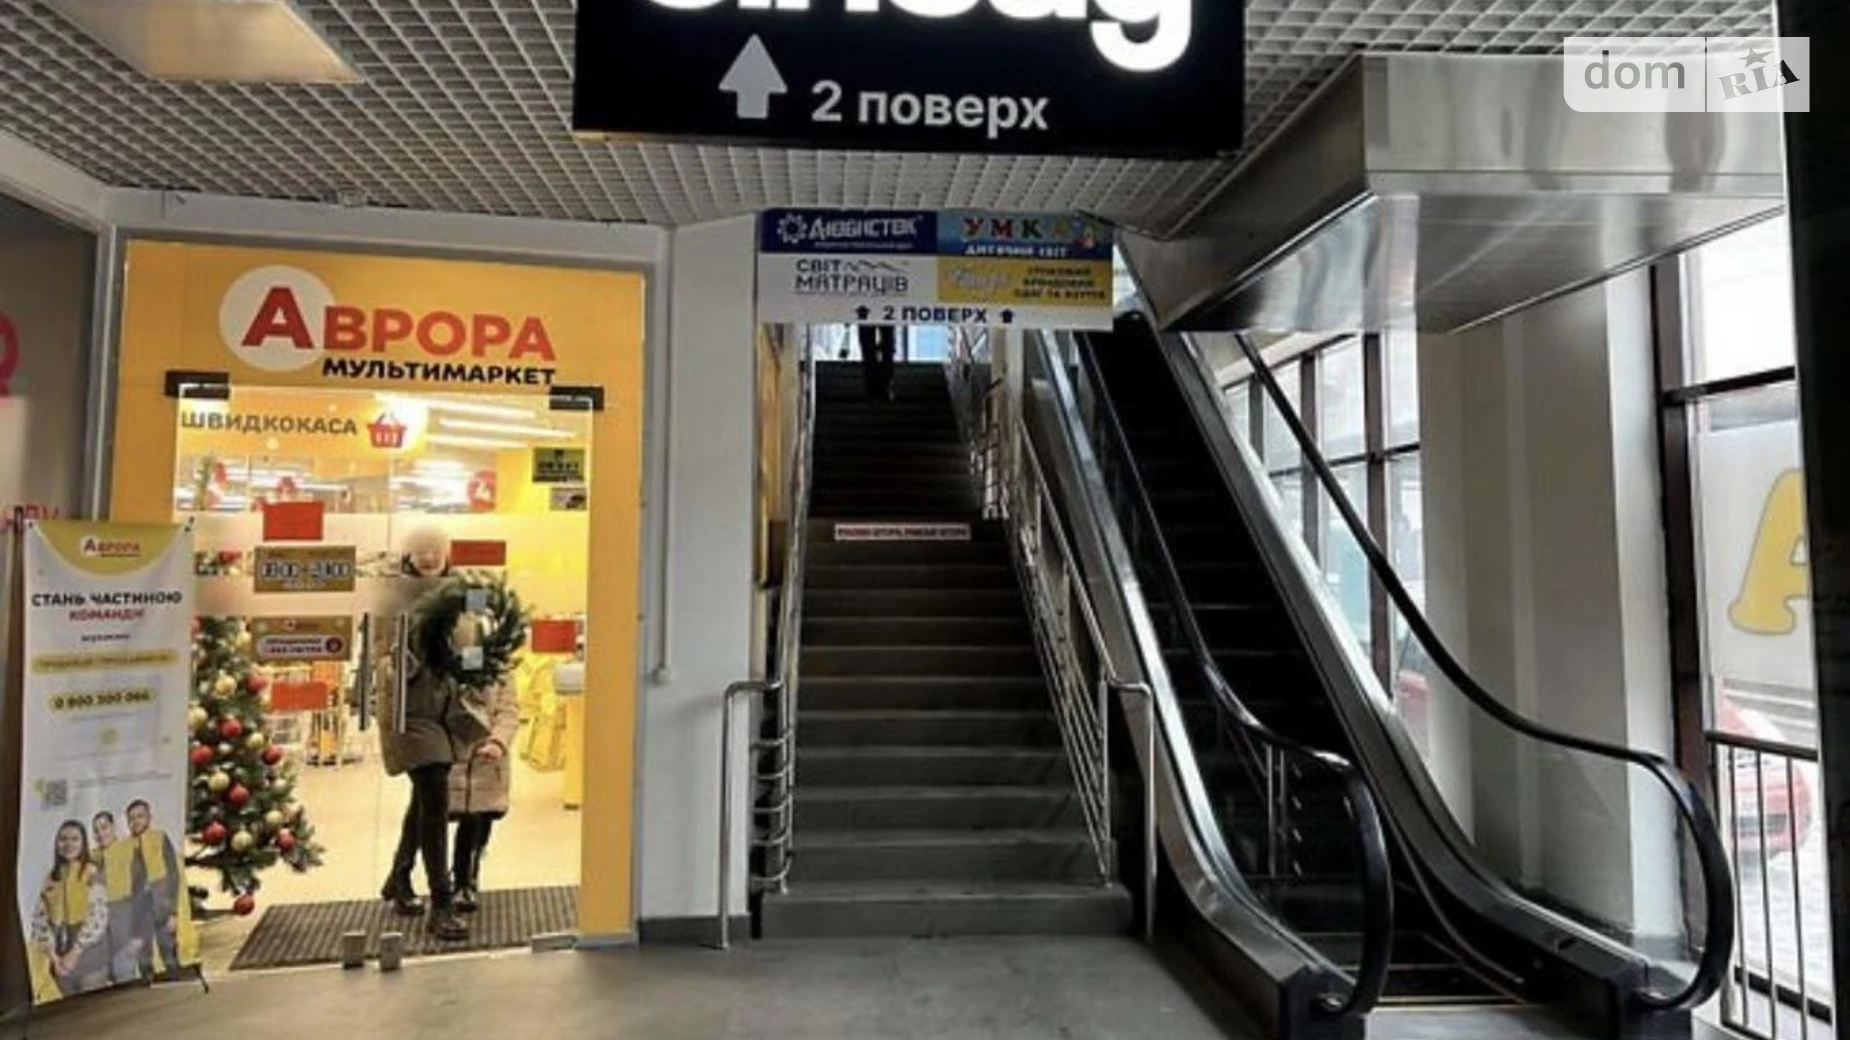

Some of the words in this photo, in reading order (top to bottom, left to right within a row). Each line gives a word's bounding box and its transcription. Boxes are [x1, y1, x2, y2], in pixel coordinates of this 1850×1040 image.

[811, 80, 843, 122] 2
[857, 91, 1048, 138] поверх
[796, 258, 842, 273] СВІТ
[795, 274, 908, 294] МАТРАЦІВ
[241, 286, 556, 361] АВРОРА
[883, 305, 895, 320] 2
[902, 306, 987, 323] ПОВЕРХ
[322, 358, 556, 385] МУЛЬТИМАРКЕТ
[181, 411, 358, 437] ШВИДКОКАСА
[32, 593, 86, 606] СТАНЬ
[91, 590, 183, 605] ЧАСТИНОЮ
